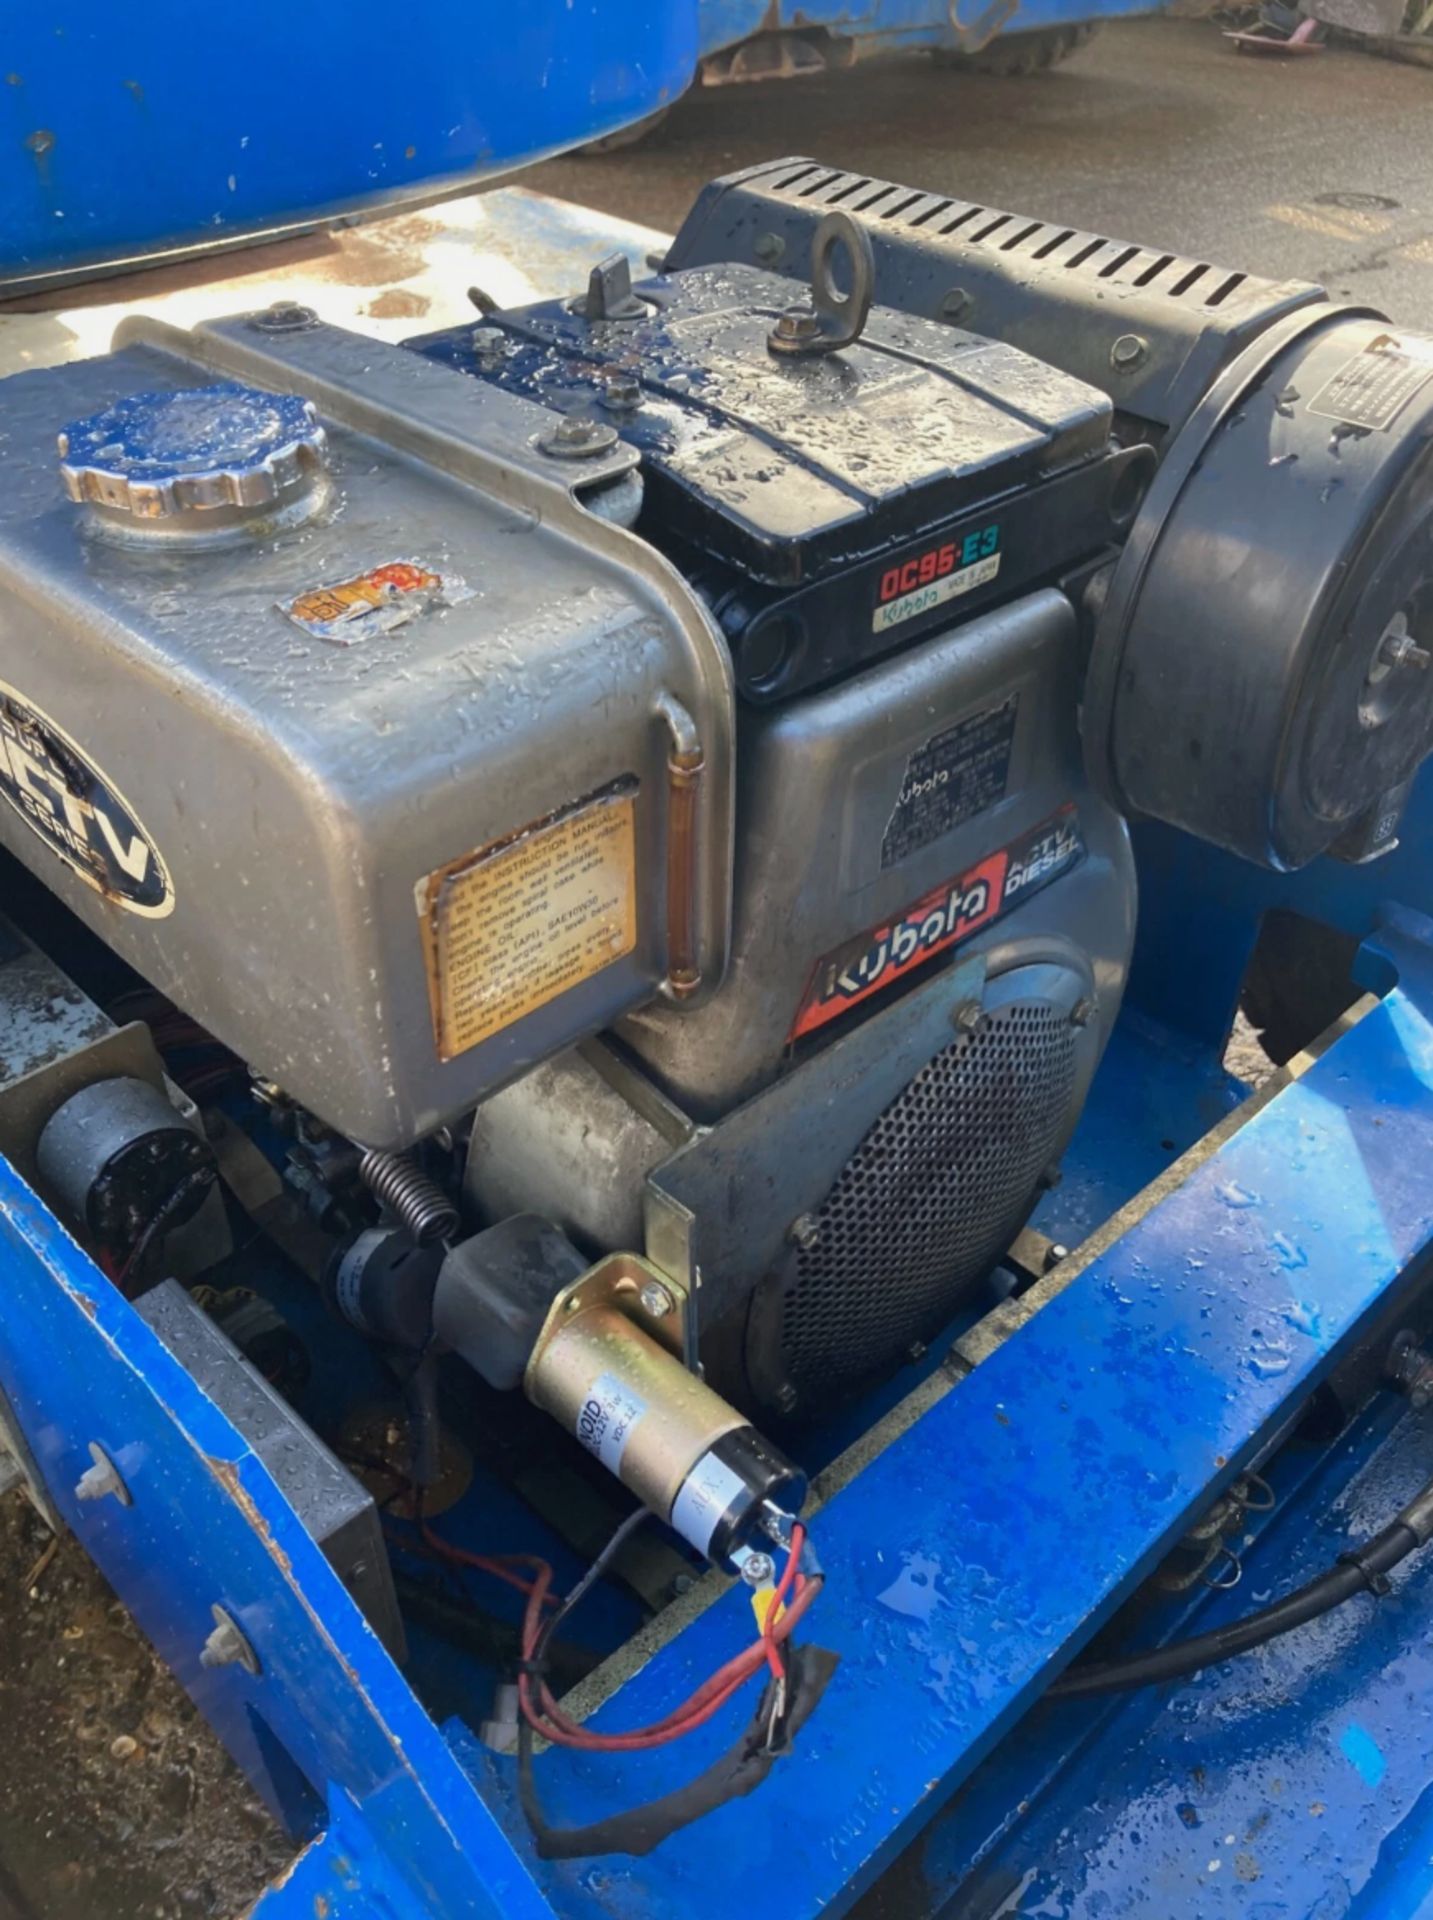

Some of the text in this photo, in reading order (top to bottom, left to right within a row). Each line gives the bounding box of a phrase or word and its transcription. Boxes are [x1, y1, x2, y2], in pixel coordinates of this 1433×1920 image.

[895, 768, 949, 809] ubota
[494, 835, 566, 881] INSTRUCTION
[1004, 835, 1079, 897] DIESEL
[826, 885, 989, 996] Kubota
